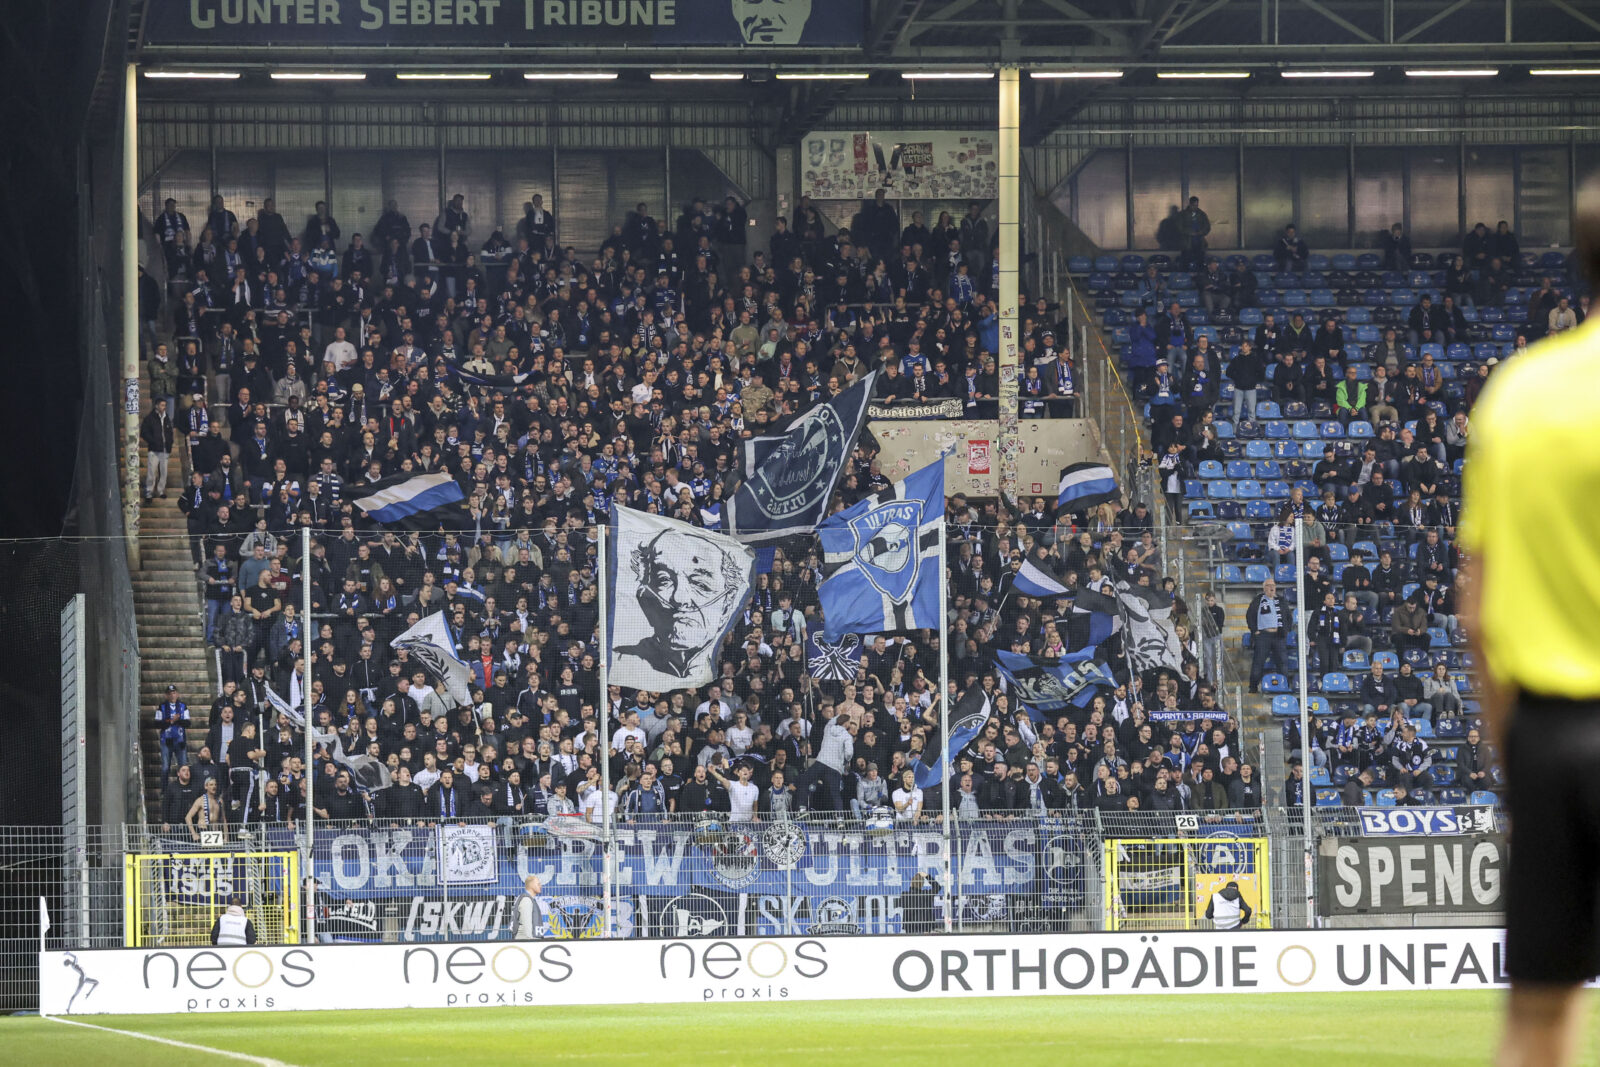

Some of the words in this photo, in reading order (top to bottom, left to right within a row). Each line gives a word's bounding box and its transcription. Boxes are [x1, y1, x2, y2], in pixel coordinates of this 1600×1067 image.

[359, 0, 500, 30] SEBERT
[865, 506, 914, 530] ULTRAS
[1152, 712, 1184, 720] AVANTI
[1192, 711, 1227, 720] ARMINIA
[1177, 816, 1196, 828] 26
[1361, 810, 1457, 835] BOYS
[203, 833, 220, 844] 27
[517, 829, 690, 887] CREW
[804, 829, 1035, 886] ULTRAS
[170, 868, 234, 897] 1905
[143, 950, 315, 989] neos
[403, 945, 574, 984] neos
[660, 940, 828, 979] neos
[892, 935, 1258, 992] ORTHOPÄDIE
[187, 995, 275, 1012] praxis
[447, 989, 534, 1006] praxis
[704, 983, 788, 1000] praxis
